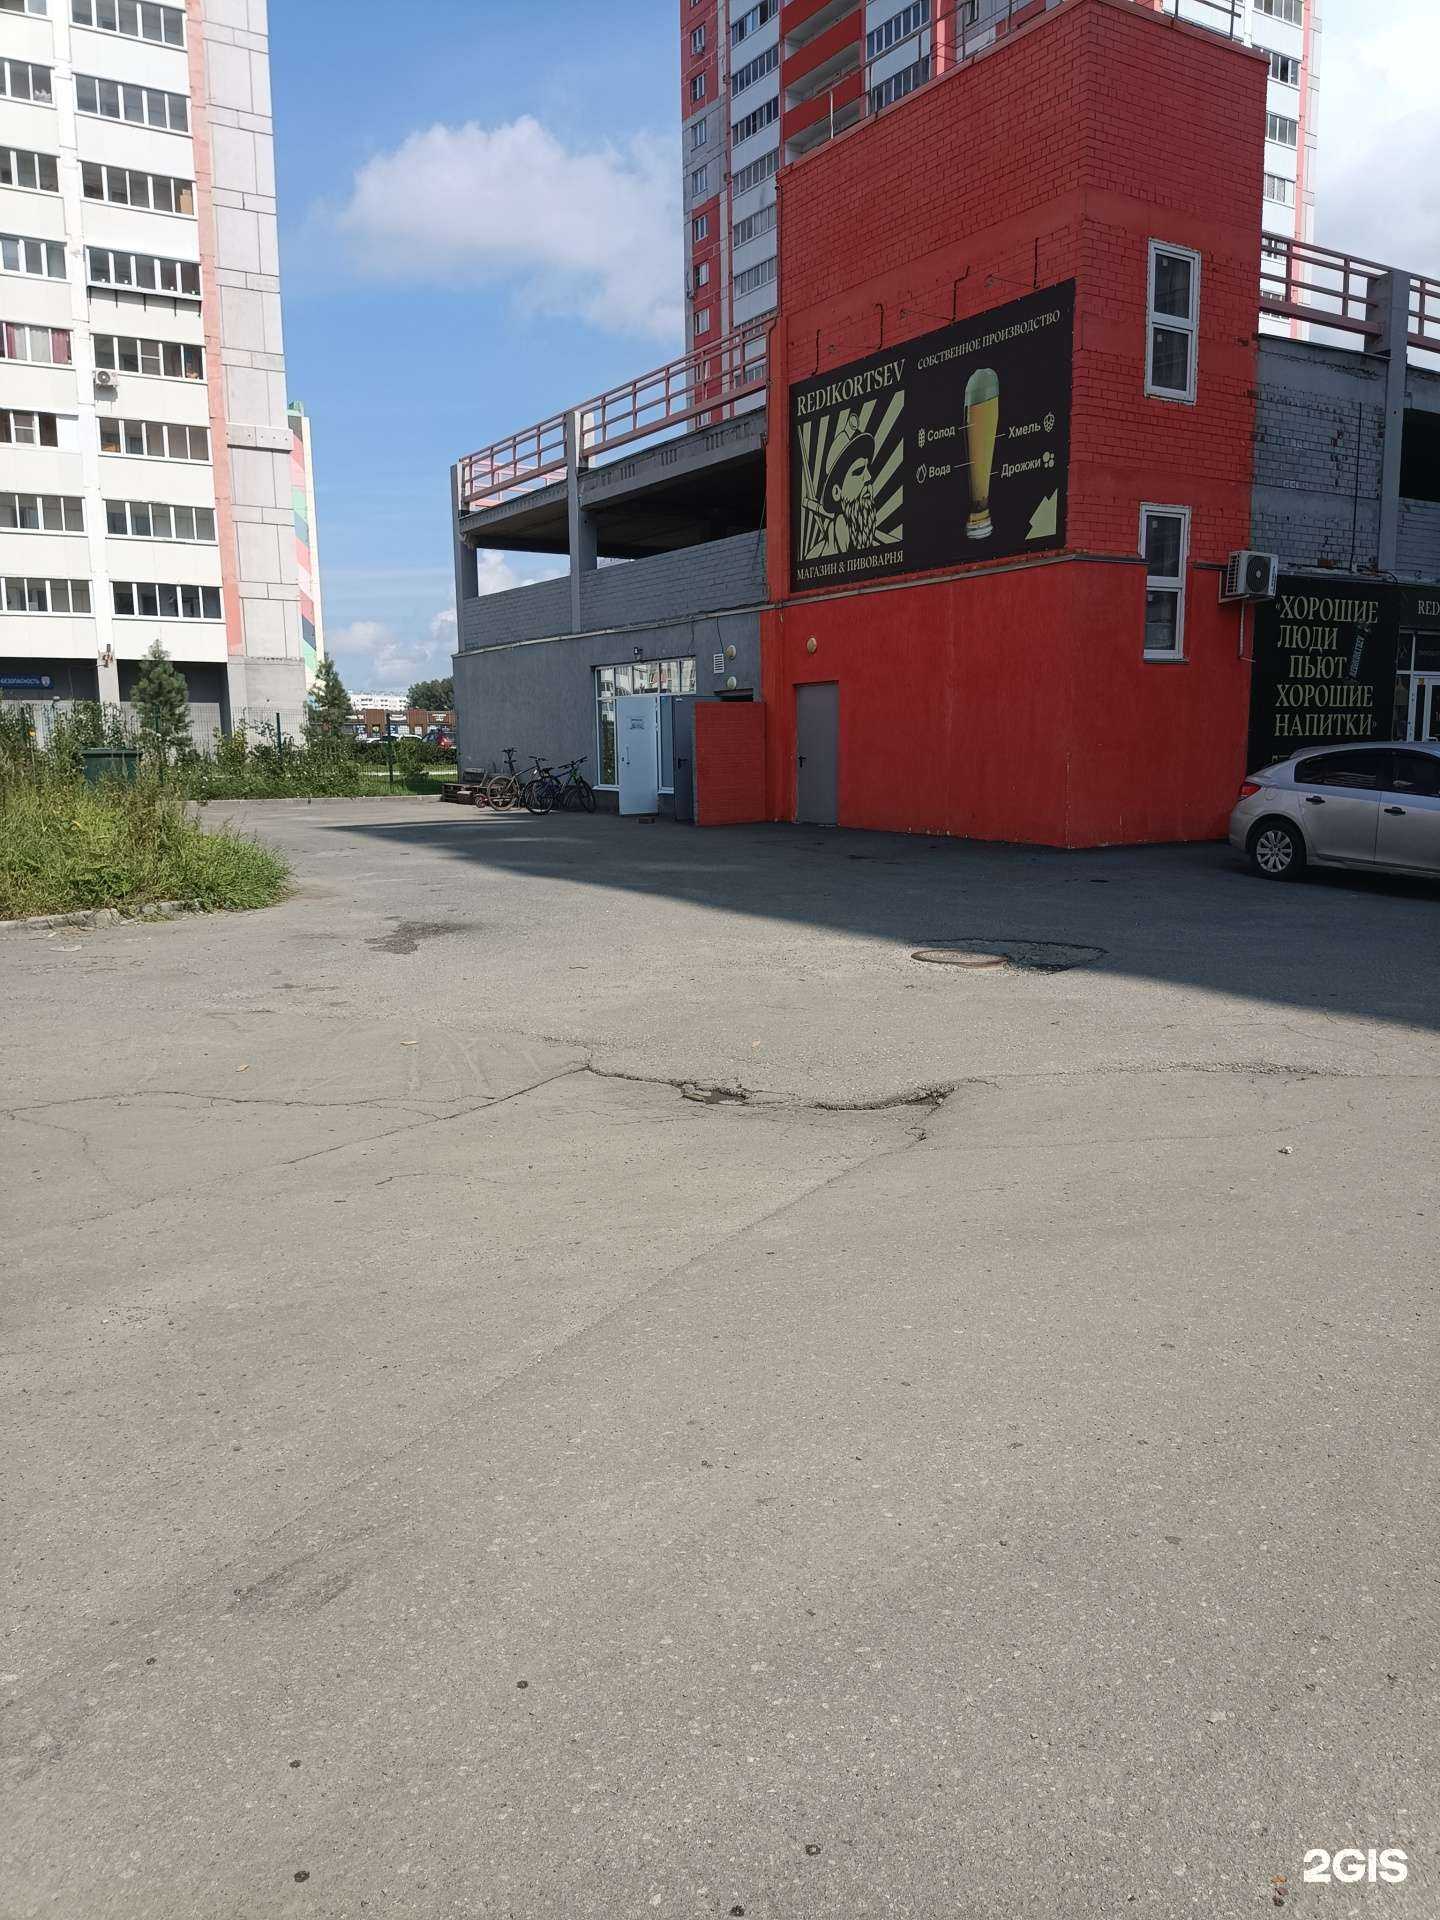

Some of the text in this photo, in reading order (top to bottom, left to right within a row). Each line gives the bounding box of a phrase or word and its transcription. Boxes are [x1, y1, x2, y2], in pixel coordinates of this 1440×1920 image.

[917, 309, 1060, 370] СОБСТВЕННОЕ ПРОИЗВОДСТВО
[797, 359, 905, 416] REDIKORTSEV
[927, 426, 955, 441] Солод
[1008, 420, 1041, 439] Хмель
[928, 463, 951, 478] Вода
[1001, 457, 1041, 478] Дрожжи
[797, 550, 903, 580] МАГАЗИН & ПИВОВАРНЯ
[1277, 625, 1339, 654] ЛЮДИ
[1289, 655, 1348, 679] ПЬЮТ
[1275, 684, 1374, 707] ХОРОШИЕ
